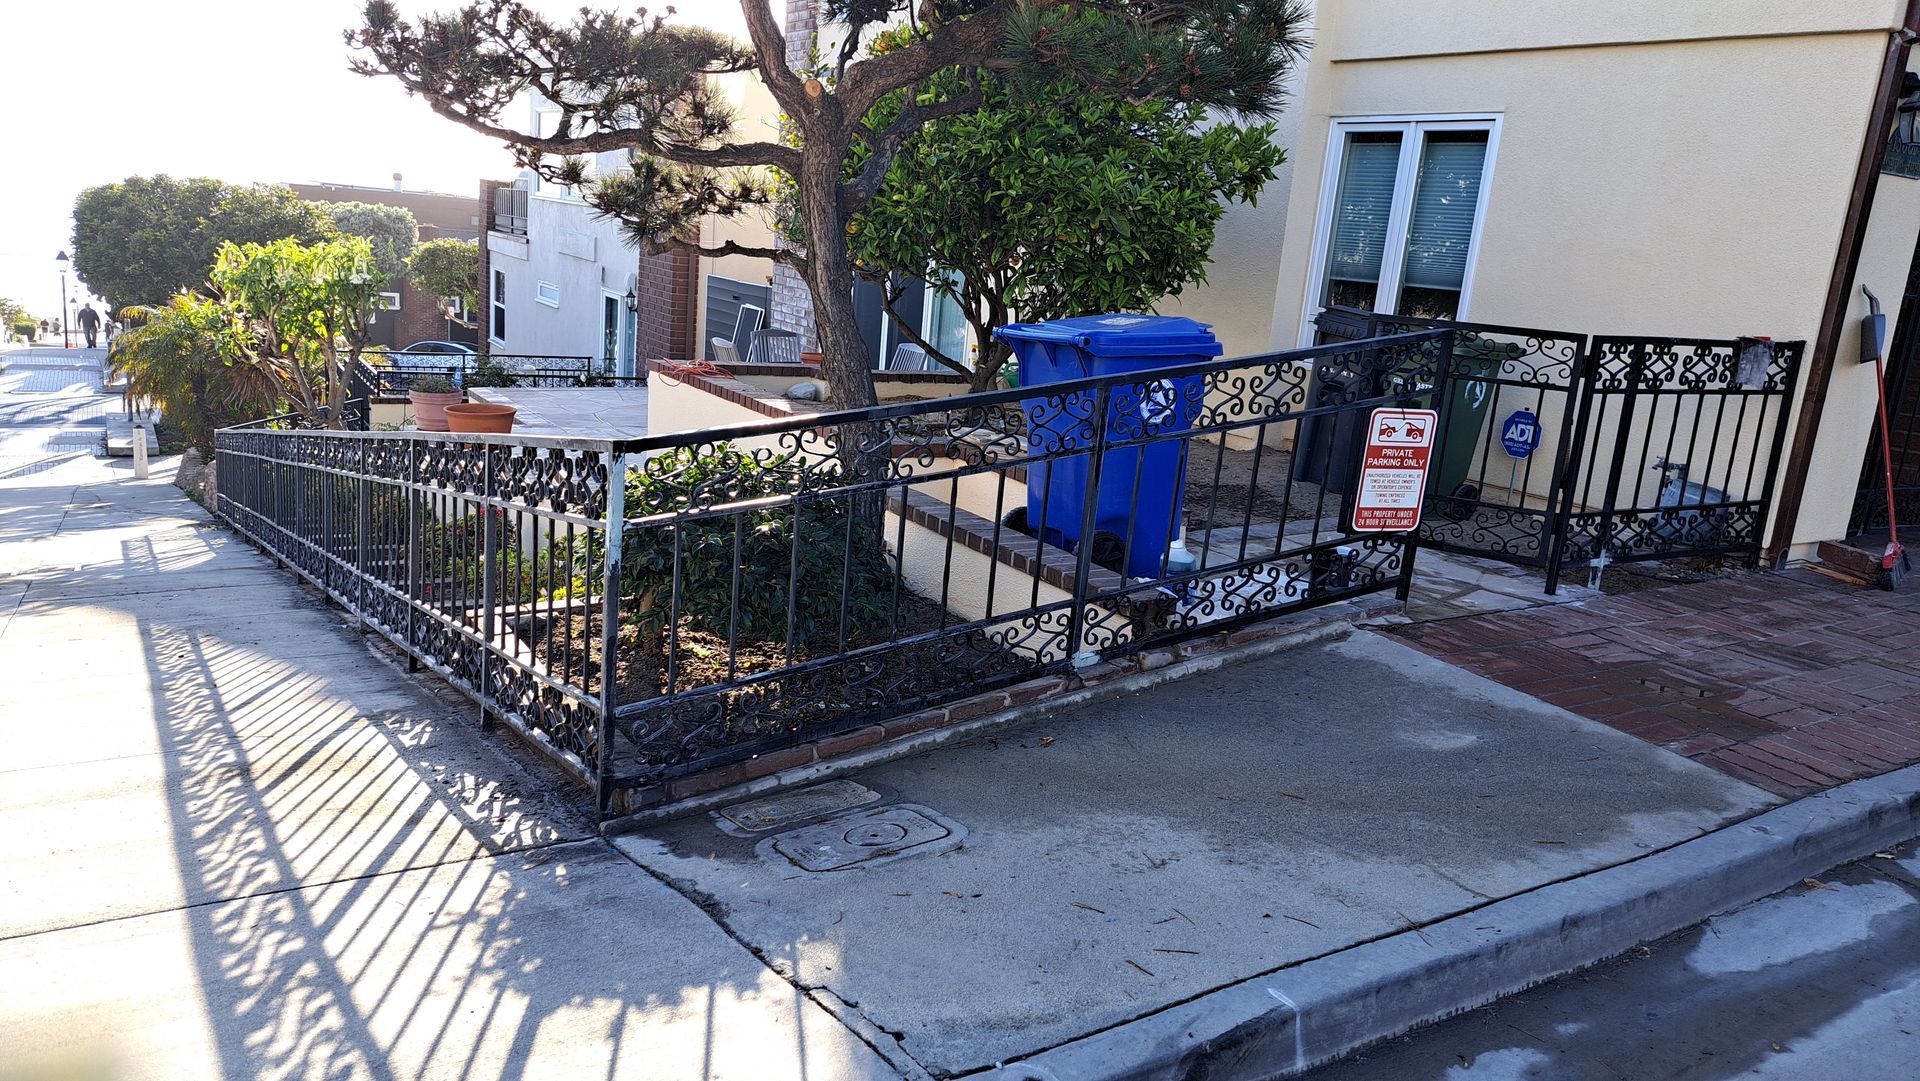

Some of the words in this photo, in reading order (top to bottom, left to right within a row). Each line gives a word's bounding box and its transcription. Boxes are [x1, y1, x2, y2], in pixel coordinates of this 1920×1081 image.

[1504, 422, 1535, 443] ADT
[1382, 448, 1414, 457] PRIVATE
[1367, 457, 1401, 466] PARKING
[1403, 458, 1424, 467] ONLY
[1372, 510, 1396, 518] PROPERTY
[1397, 510, 1413, 518] UNDER
[1365, 518, 1379, 526] HOUR
